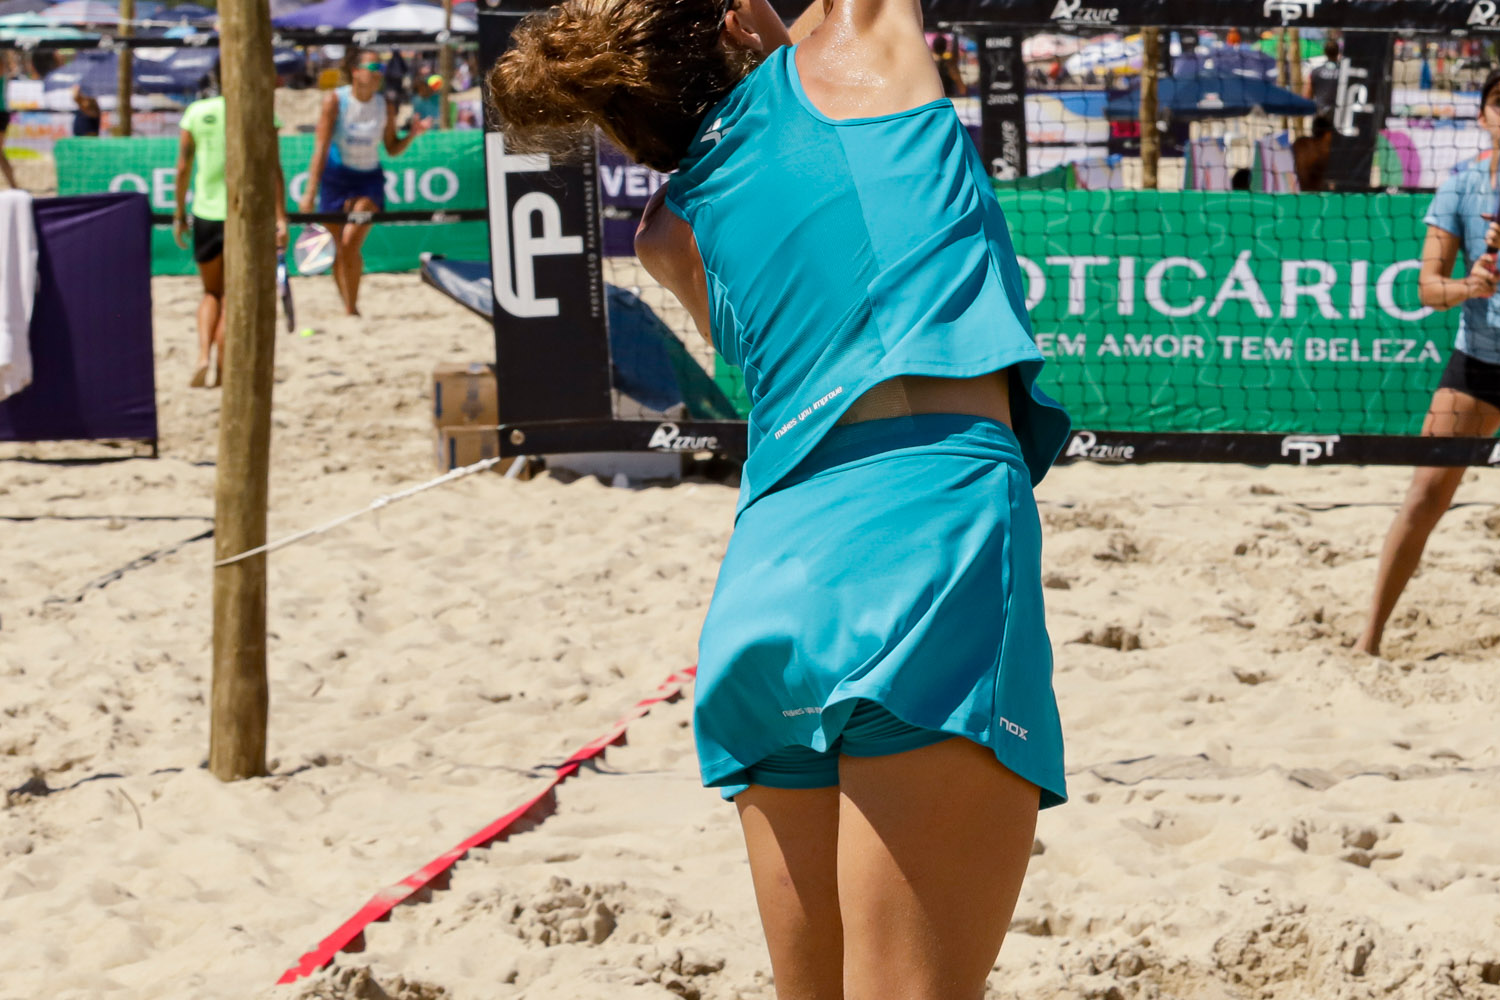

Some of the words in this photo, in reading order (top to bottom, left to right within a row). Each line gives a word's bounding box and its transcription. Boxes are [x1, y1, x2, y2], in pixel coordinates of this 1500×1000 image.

[1097, 333, 1205, 359] AMOR
[1216, 336, 1294, 361] TEM
[1304, 337, 1442, 364] BELEZA
[774, 417, 798, 440] makes
[797, 406, 813, 421] you
[812, 385, 843, 410] improve
